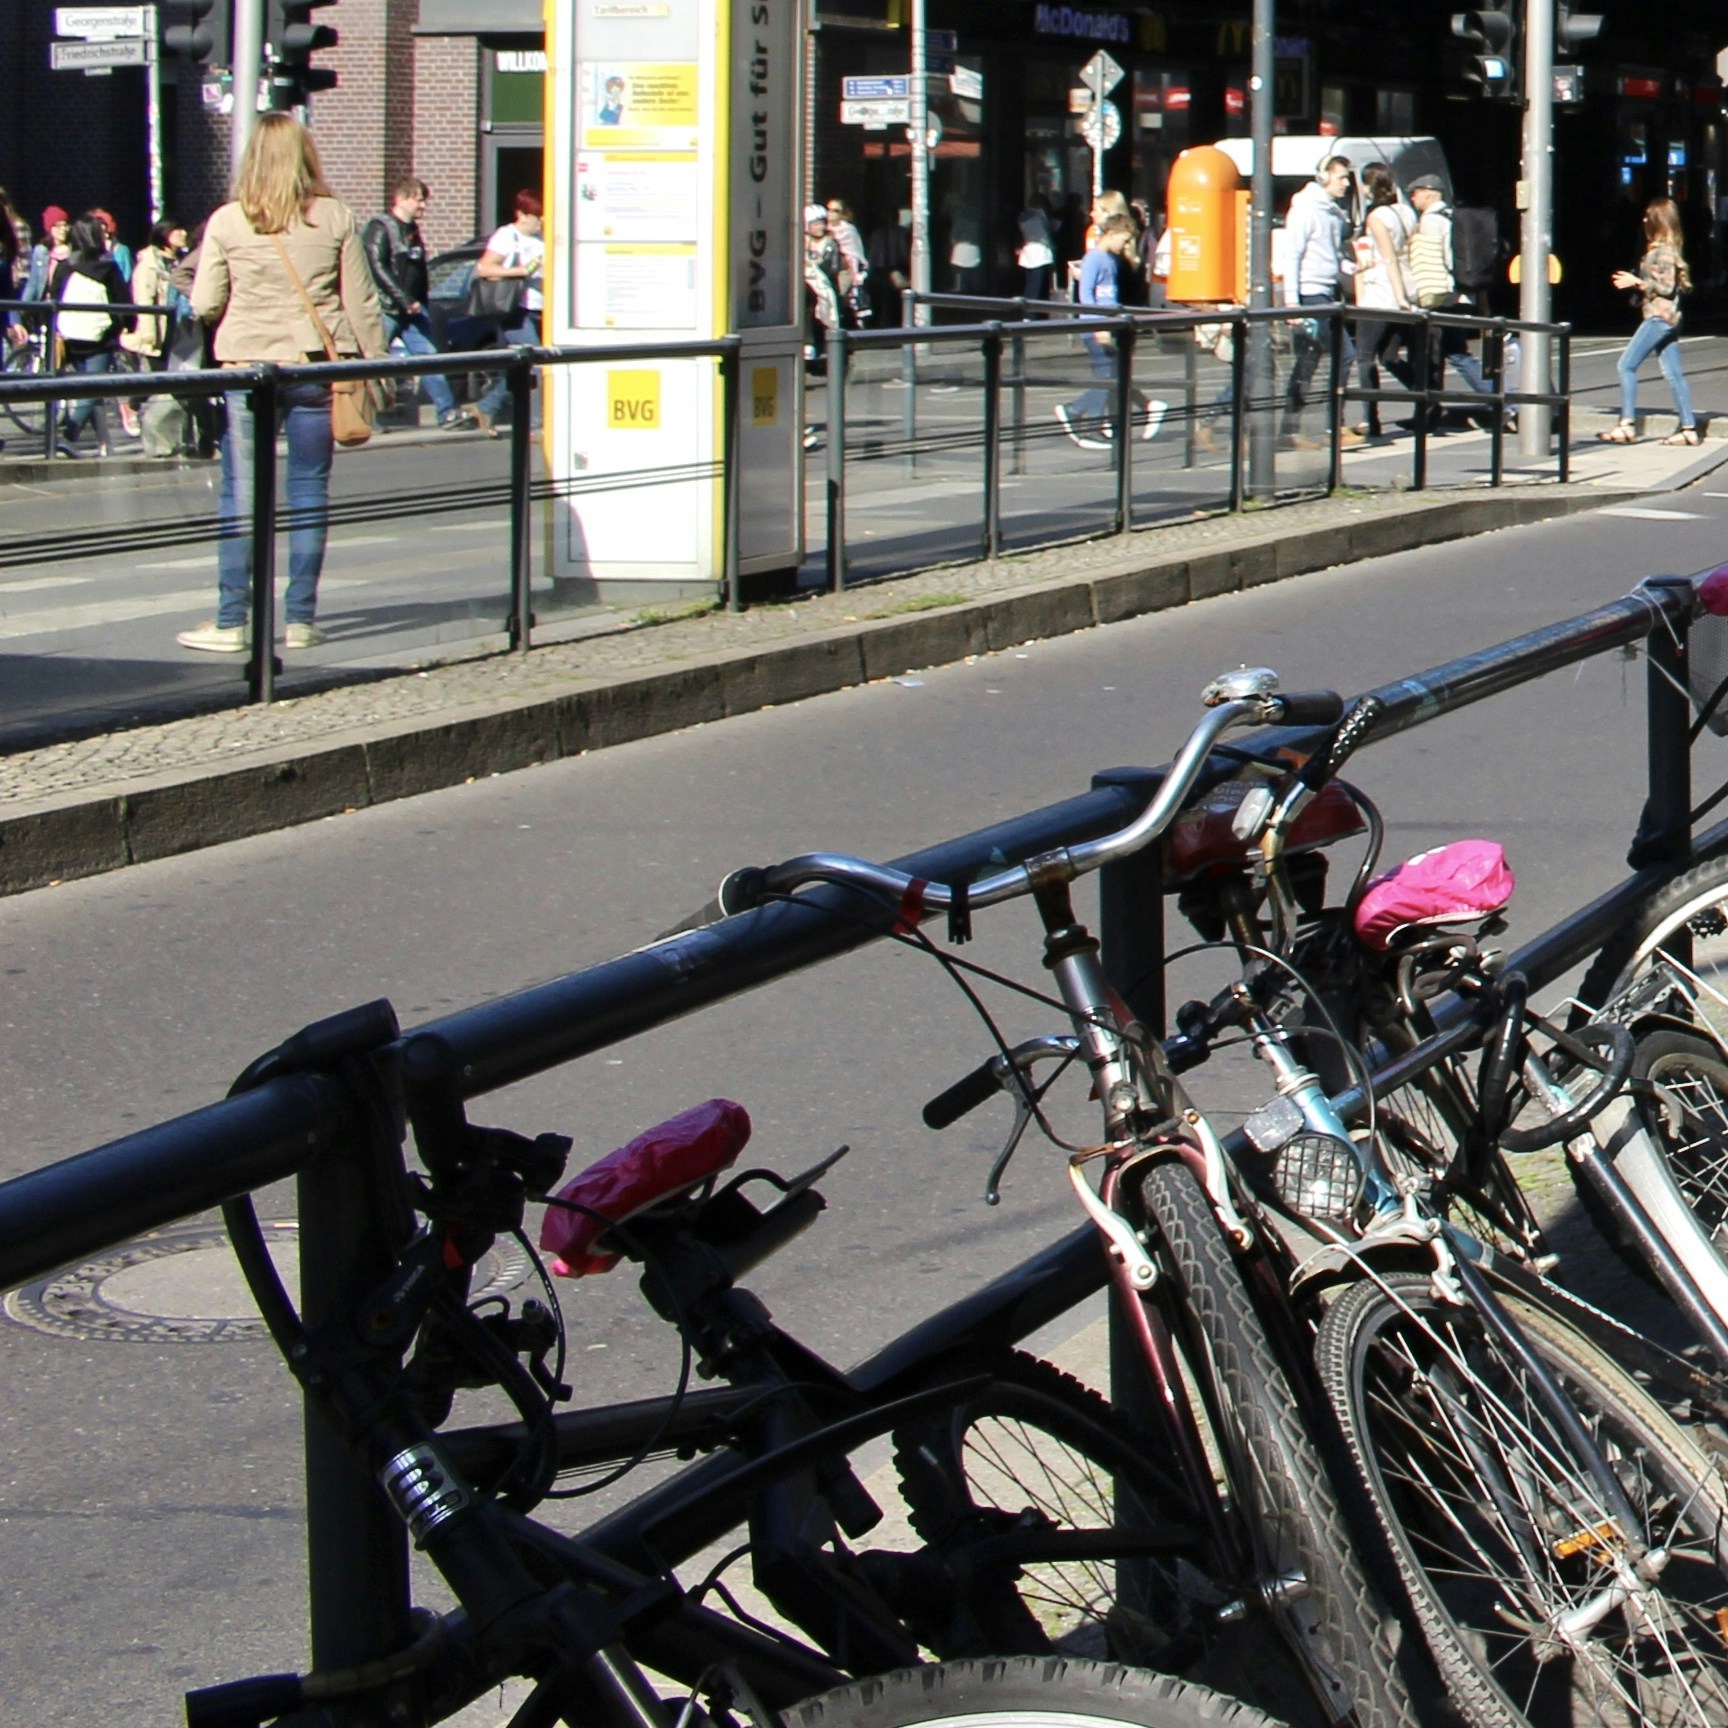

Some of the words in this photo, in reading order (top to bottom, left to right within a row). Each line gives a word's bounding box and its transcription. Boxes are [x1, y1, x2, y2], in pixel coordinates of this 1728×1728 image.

[1035, 4, 1131, 42] McDonald's
[60, 44, 137, 61] Friedrichstraße
[748, 39, 769, 98] für
[749, 110, 769, 184] Gut
[748, 229, 767, 313] BVG
[613, 399, 654, 422] BVG
[754, 396, 774, 418] BVG
